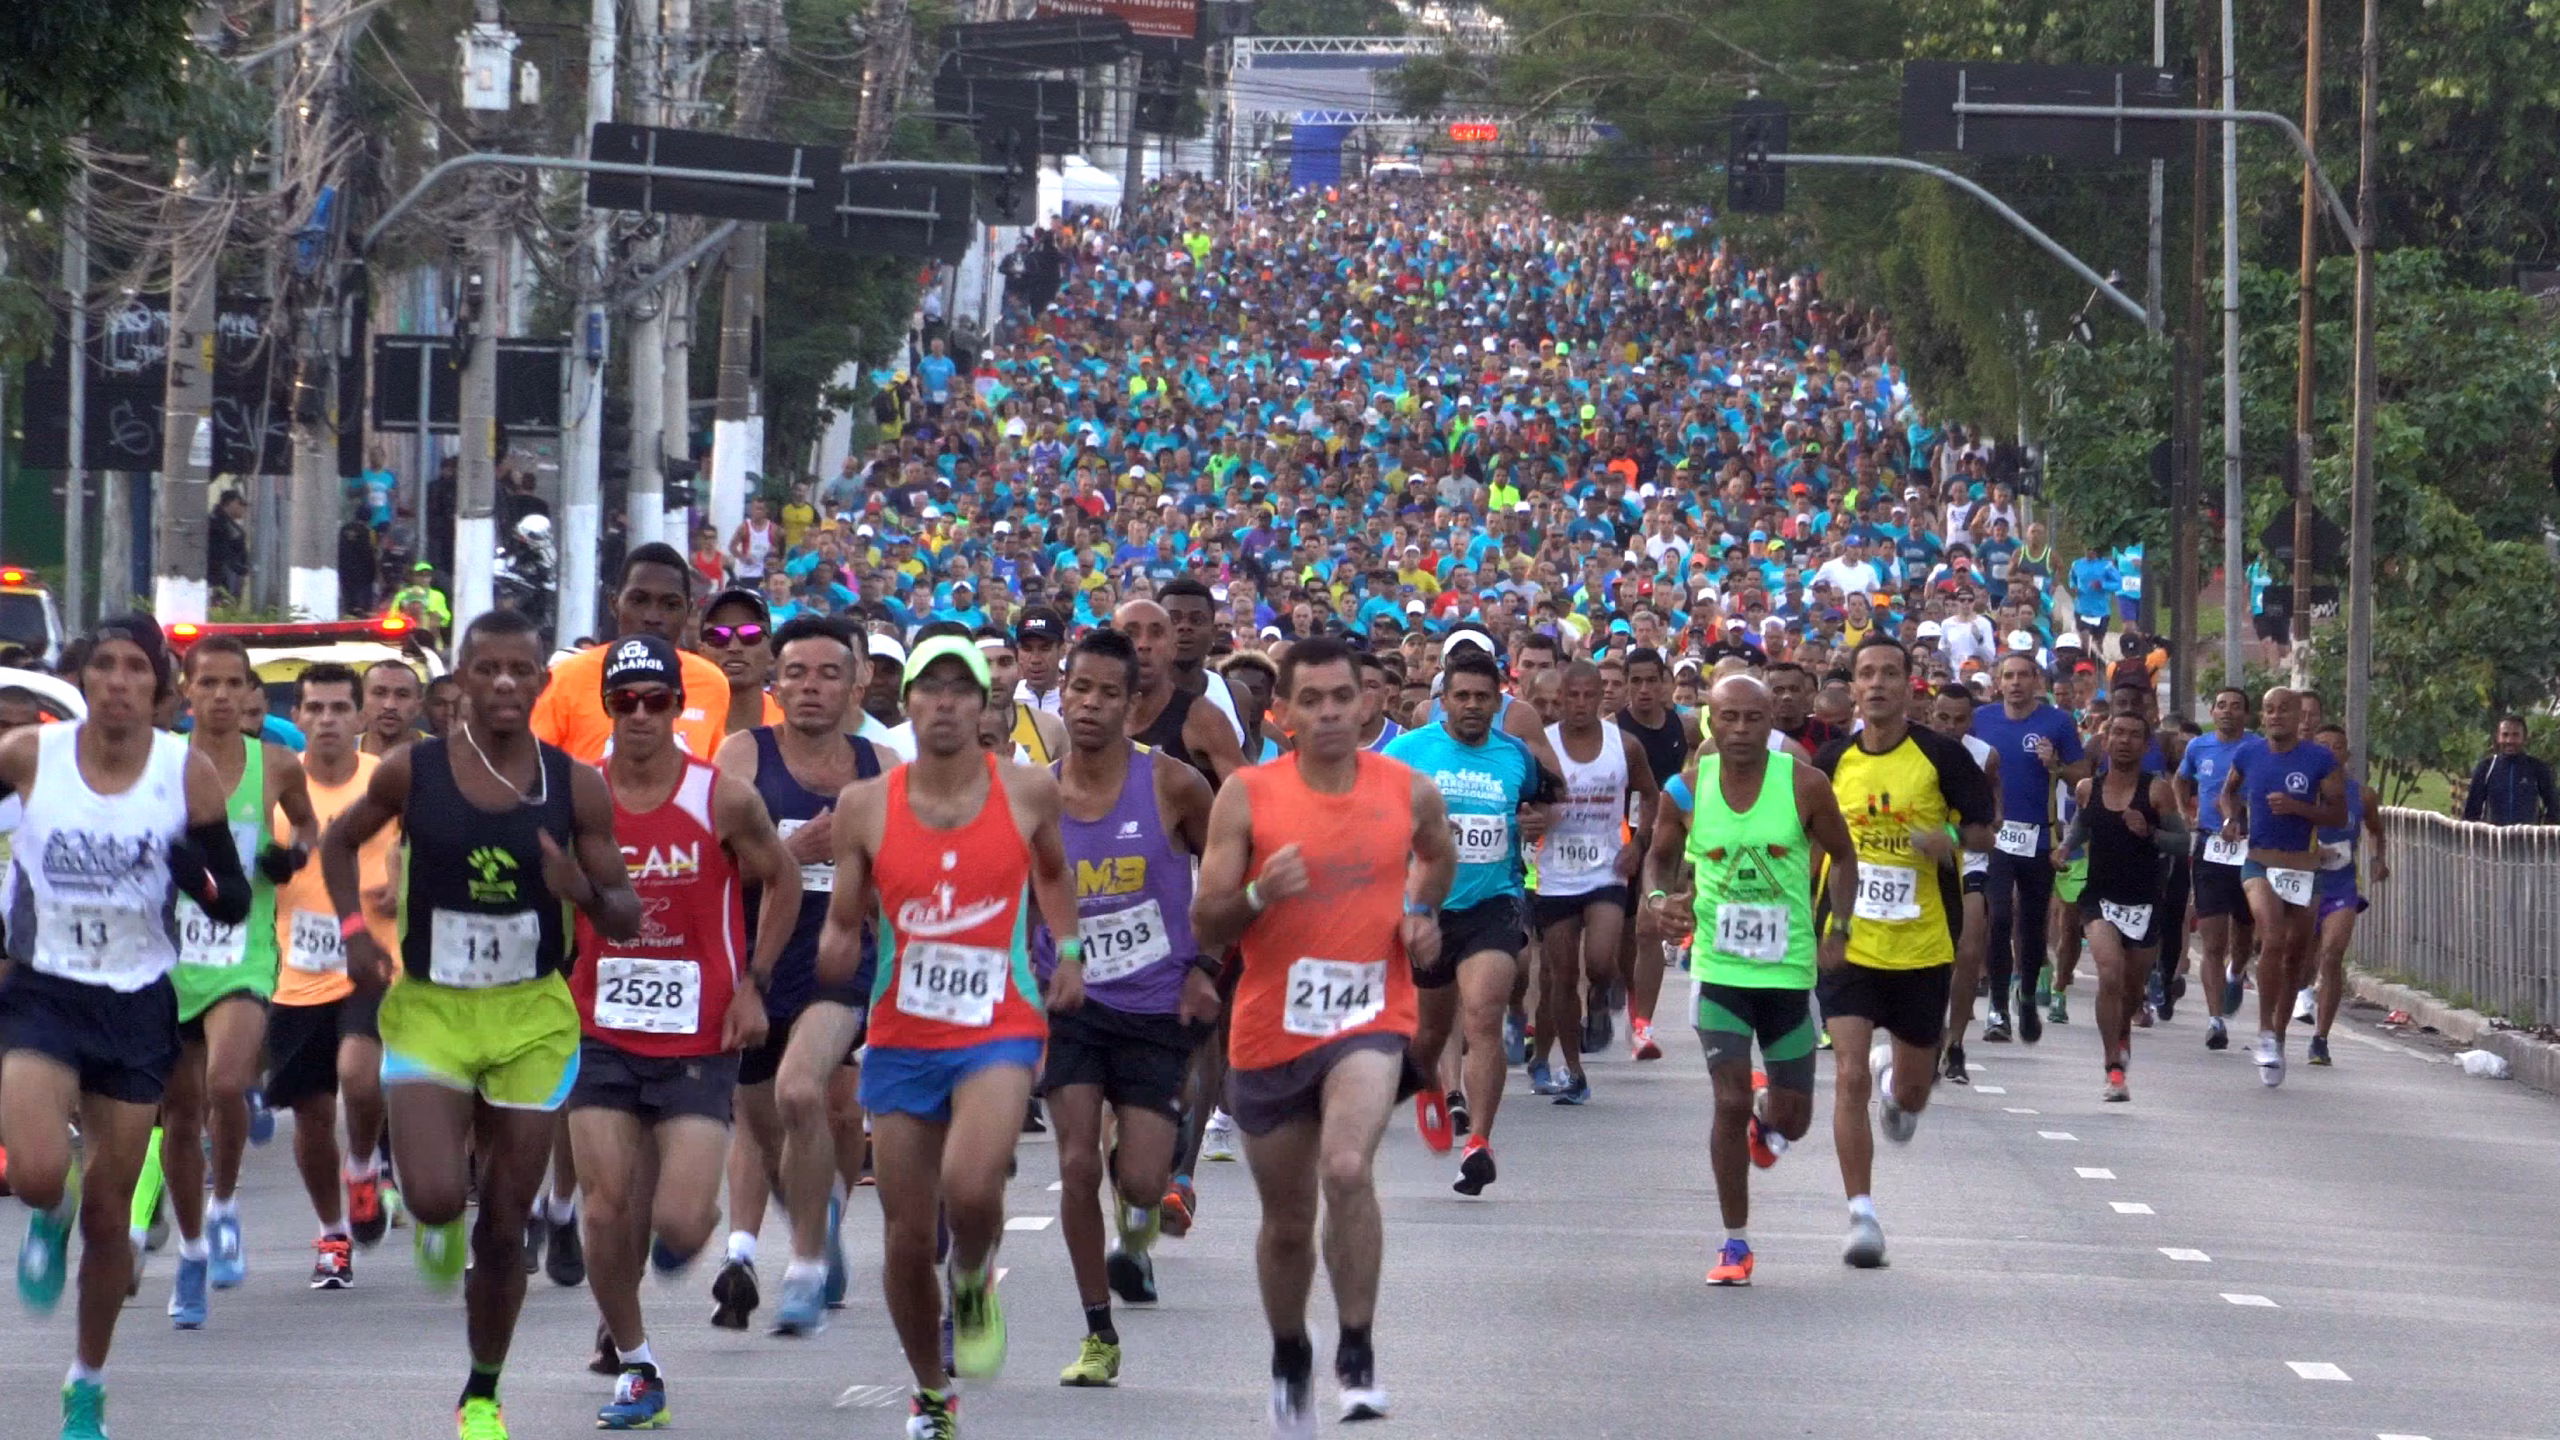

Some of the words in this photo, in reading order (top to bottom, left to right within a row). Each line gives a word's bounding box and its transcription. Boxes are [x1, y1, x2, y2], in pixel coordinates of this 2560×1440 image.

[1455, 828, 1503, 847] 1607
[2000, 830, 2026, 844] 880
[2213, 841, 2237, 855] 870
[1559, 846, 1599, 861] 1960
[1858, 879, 1911, 902] 1687
[70, 920, 108, 947] 13
[186, 919, 231, 946] 632
[1083, 922, 1151, 959] 1793
[1722, 918, 1777, 943] 1541
[464, 936, 502, 963] 14
[605, 977, 683, 1009] 2528
[912, 961, 988, 998] 1886
[1293, 979, 1371, 1011] 2144
